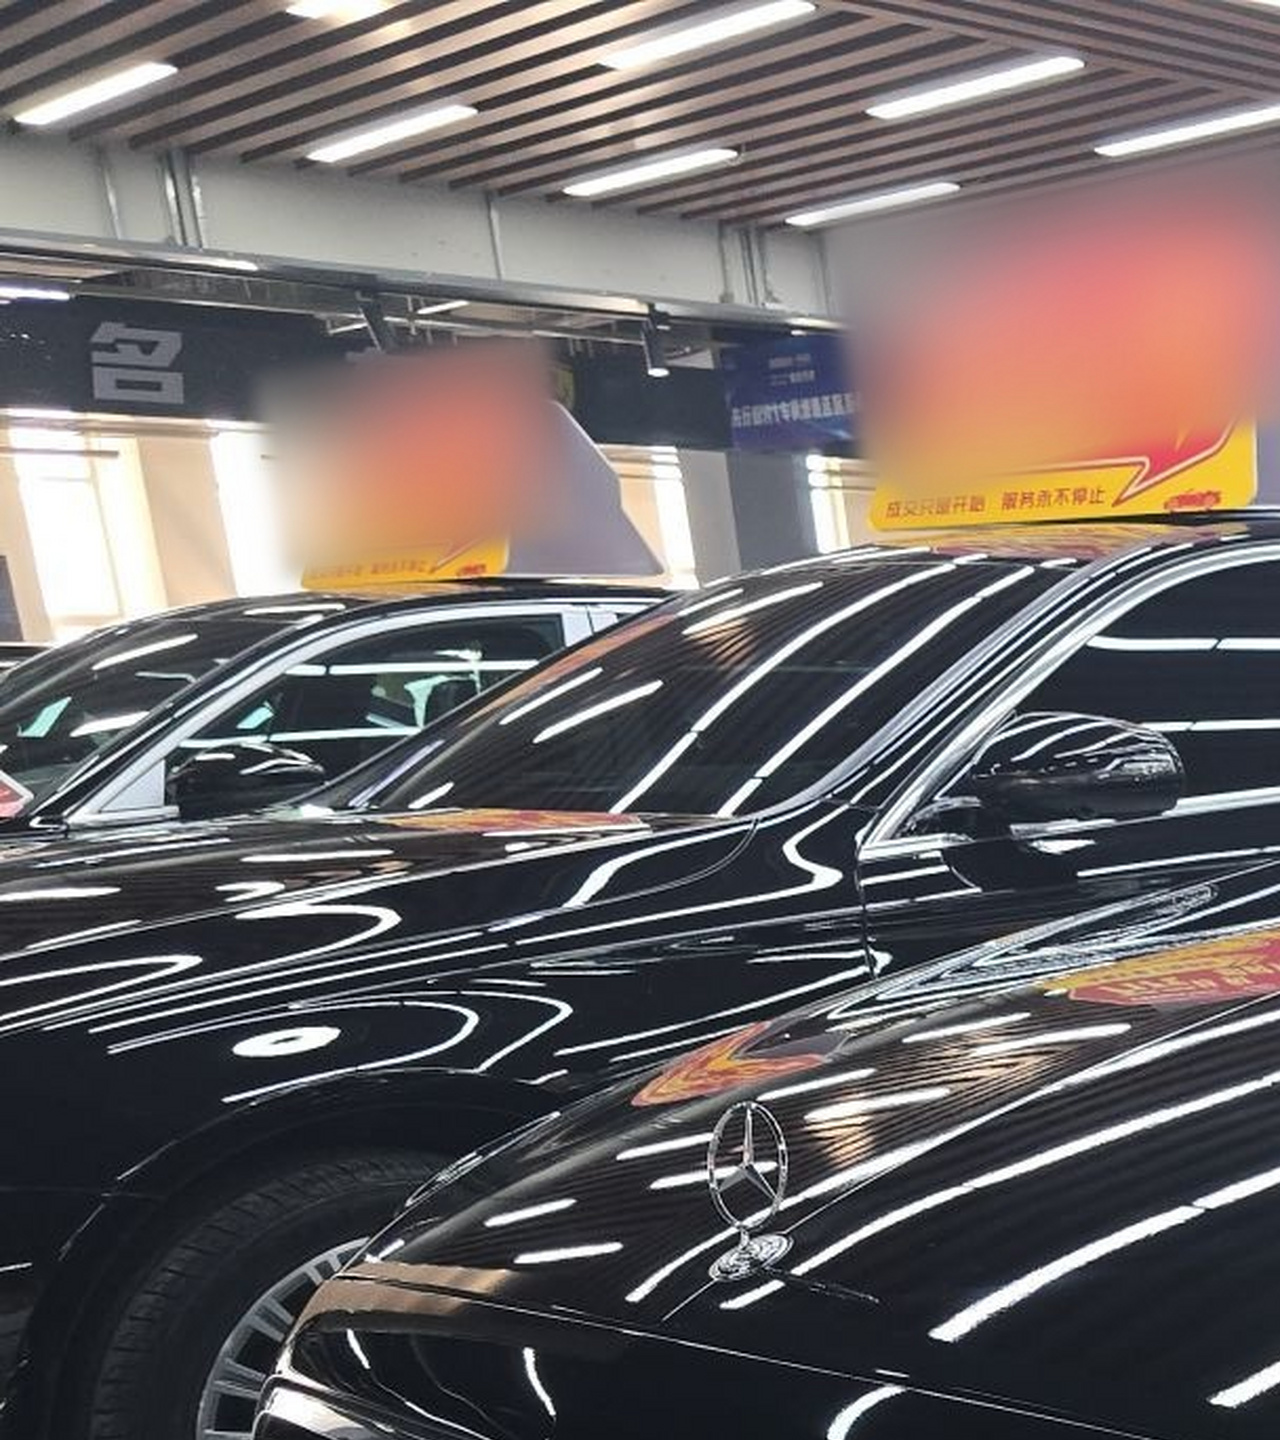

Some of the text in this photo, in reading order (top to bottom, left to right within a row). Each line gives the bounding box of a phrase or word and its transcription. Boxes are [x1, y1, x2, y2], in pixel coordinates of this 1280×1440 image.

[90, 321, 184, 404] 名
[1001, 487, 1105, 511] 服务永不停止
